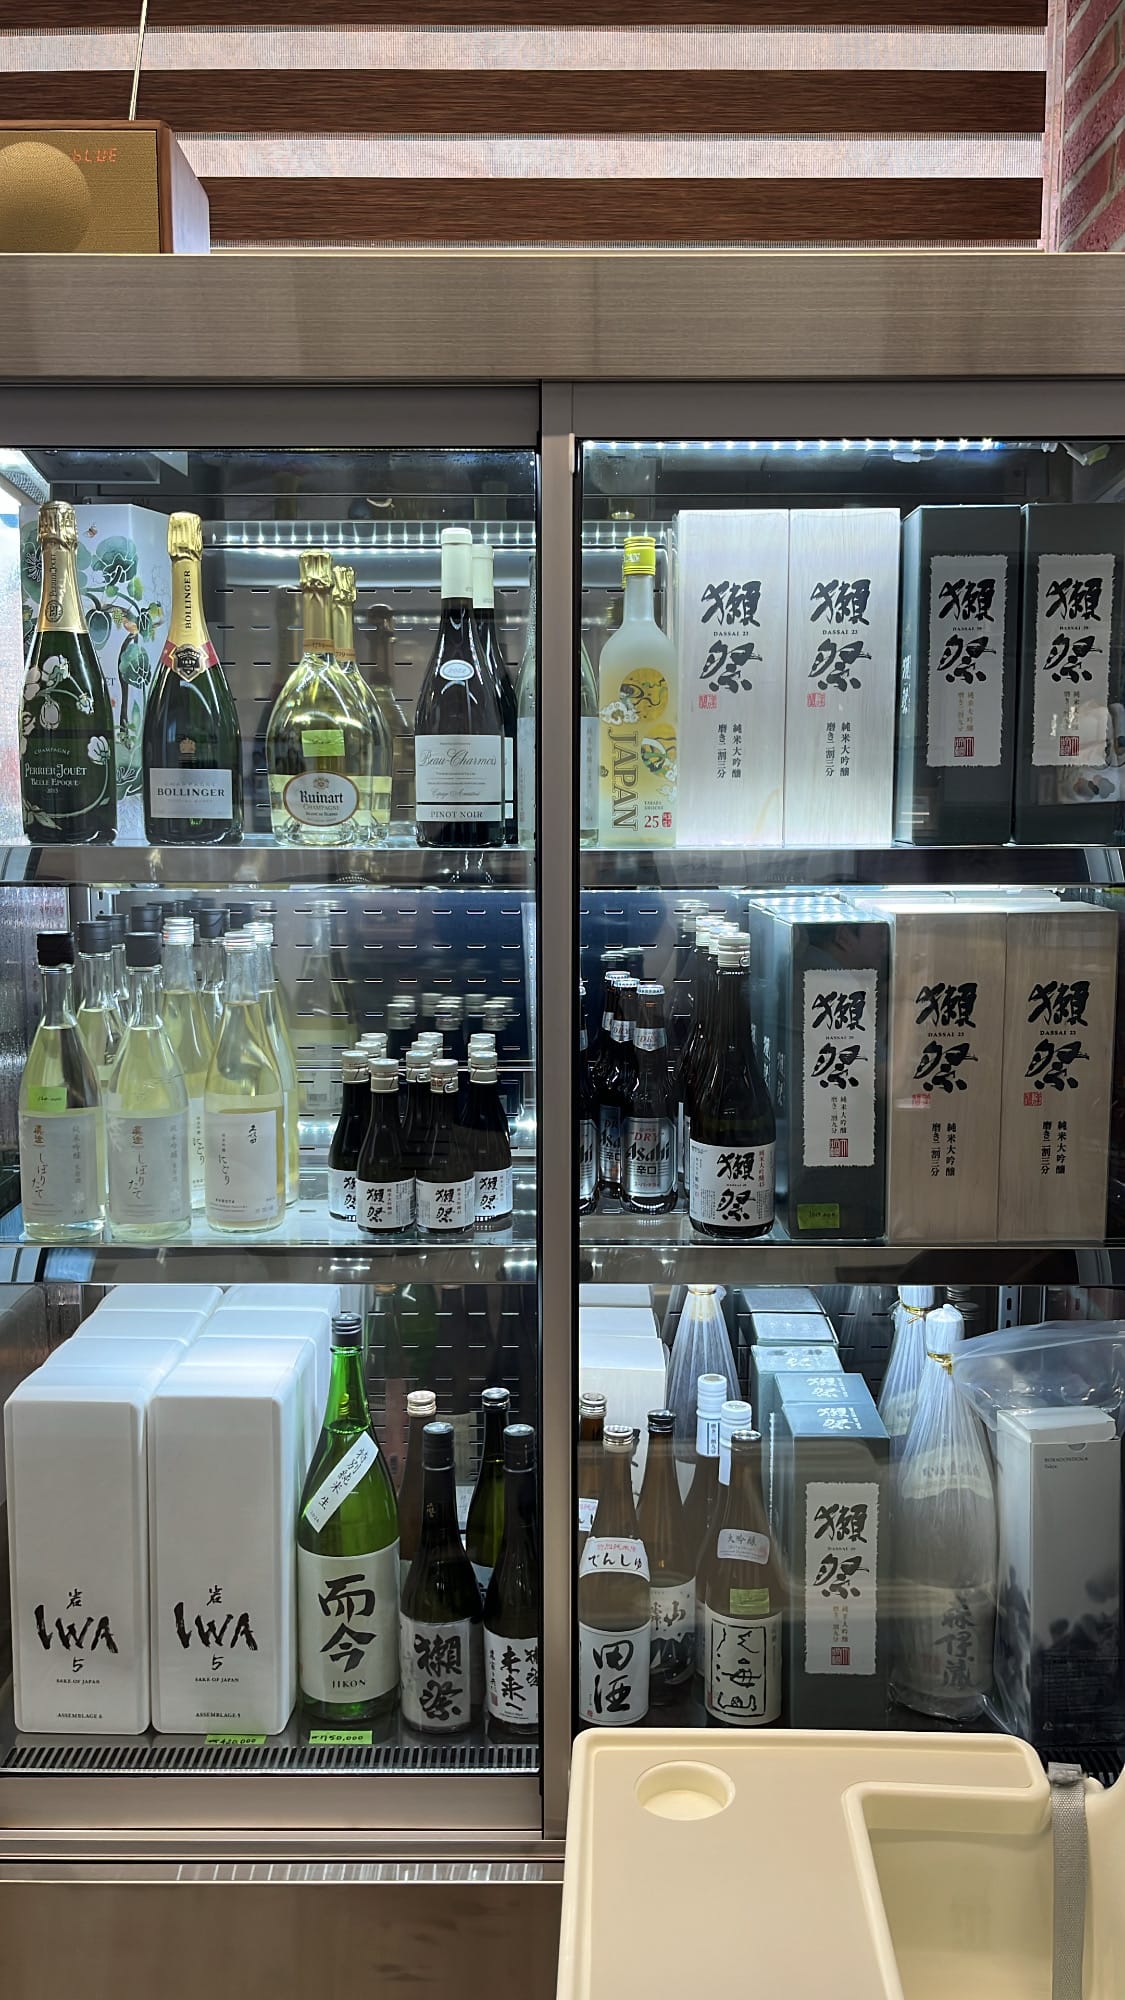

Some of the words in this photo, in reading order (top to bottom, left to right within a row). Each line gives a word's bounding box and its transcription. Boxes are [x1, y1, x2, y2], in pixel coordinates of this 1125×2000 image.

[700, 580, 763, 693] 獺祭
[808, 579, 872, 692] 獺祭
[937, 578, 996, 684] 獺祭
[1043, 577, 1102, 684] 獺祭
[732, 723, 742, 778] 純米大吟醸
[840, 721, 850, 777] 純米大吟醸
[156, 787, 225, 797] BOLLINGER
[300, 790, 344, 804] Ruinart
[608, 727, 639, 831] JAPAN
[431, 810, 457, 818] PINOT
[460, 810, 482, 818] NOIR
[644, 815, 659, 828] 25
[811, 991, 868, 1090] 獺祭
[913, 982, 978, 1093] 獺祭
[1024, 980, 1090, 1091] 獺祭
[625, 1142, 670, 1161] Asahi
[637, 1166, 657, 1174] 辛口
[945, 1122, 956, 1177] 純米大吟醸
[1056, 1120, 1067, 1174] 純米大吟醸
[716, 1152, 756, 1221] 獺祭
[318, 1496, 329, 1510] 生
[588, 1553, 643, 1570] でんしゅ
[813, 1503, 870, 1599] 獺祭
[66, 1588, 83, 1609] 岩
[206, 1585, 222, 1606] 岩
[34, 1604, 118, 1654] IWA
[174, 1601, 258, 1651] IWA
[318, 1574, 377, 1673] 而今
[72, 1656, 84, 1673] 5
[212, 1654, 224, 1670] 5
[331, 1677, 366, 1689] JIKON
[592, 1639, 634, 1714] 田酒
